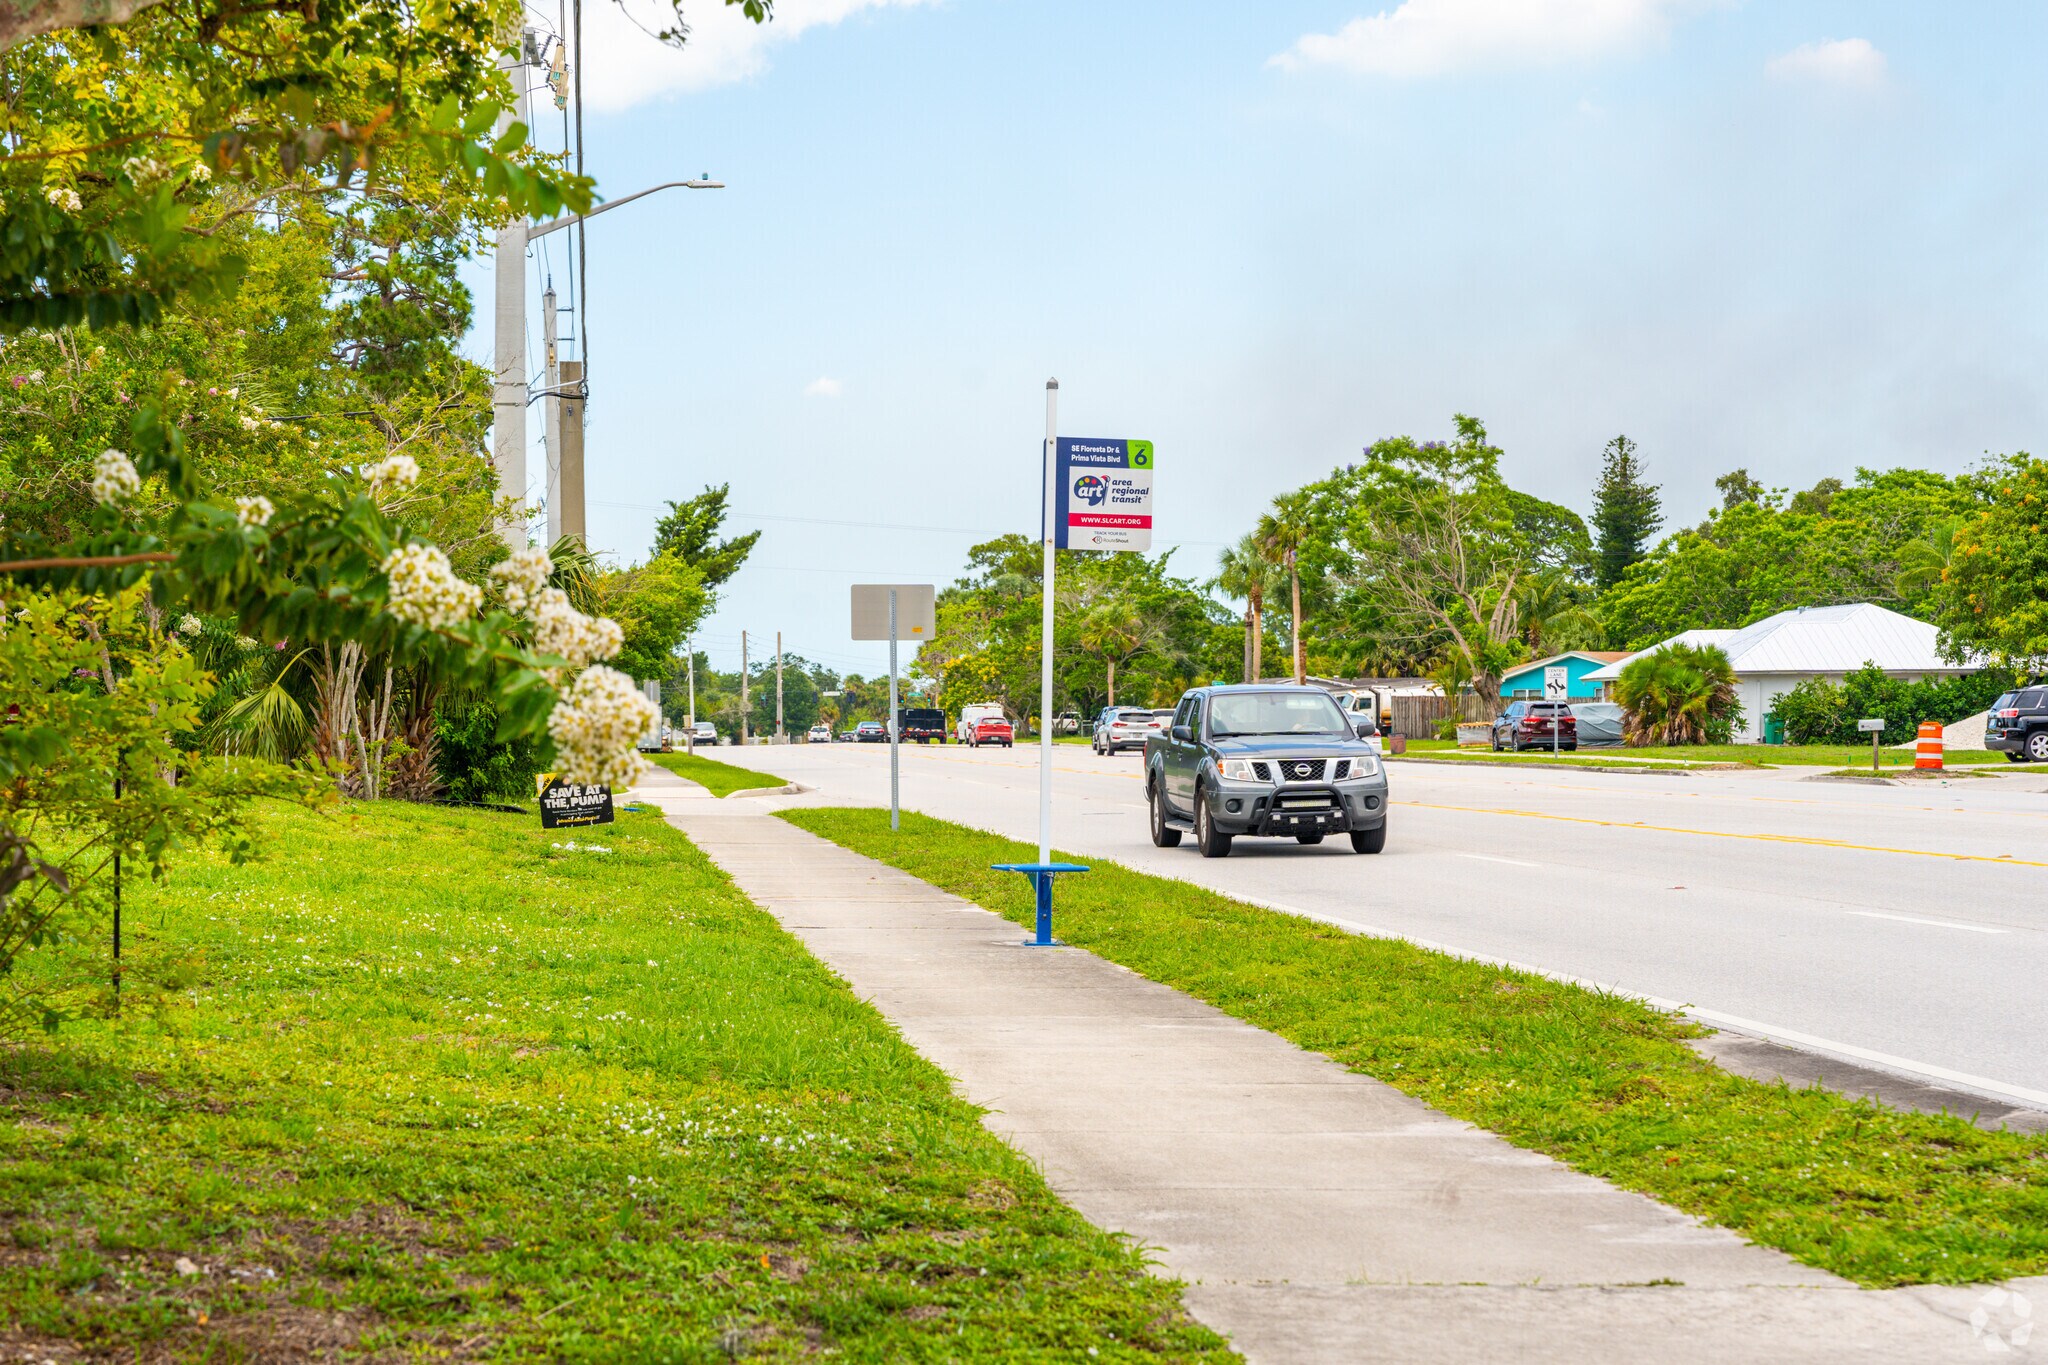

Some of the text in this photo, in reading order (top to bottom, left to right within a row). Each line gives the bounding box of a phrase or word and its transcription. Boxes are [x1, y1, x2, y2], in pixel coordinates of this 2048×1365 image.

[1080, 445, 1106, 453] Floresta
[1071, 454, 1090, 462] Prima
[1107, 455, 1121, 463] Blvd
[1134, 448, 1148, 466] 6
[1078, 485, 1103, 498] art
[1111, 487, 1150, 496] regional
[1111, 495, 1142, 504] transit
[1080, 516, 1141, 525] WWW.SLCART.ORG
[548, 784, 601, 799] SAVE AT
[570, 793, 608, 807] PUMP
